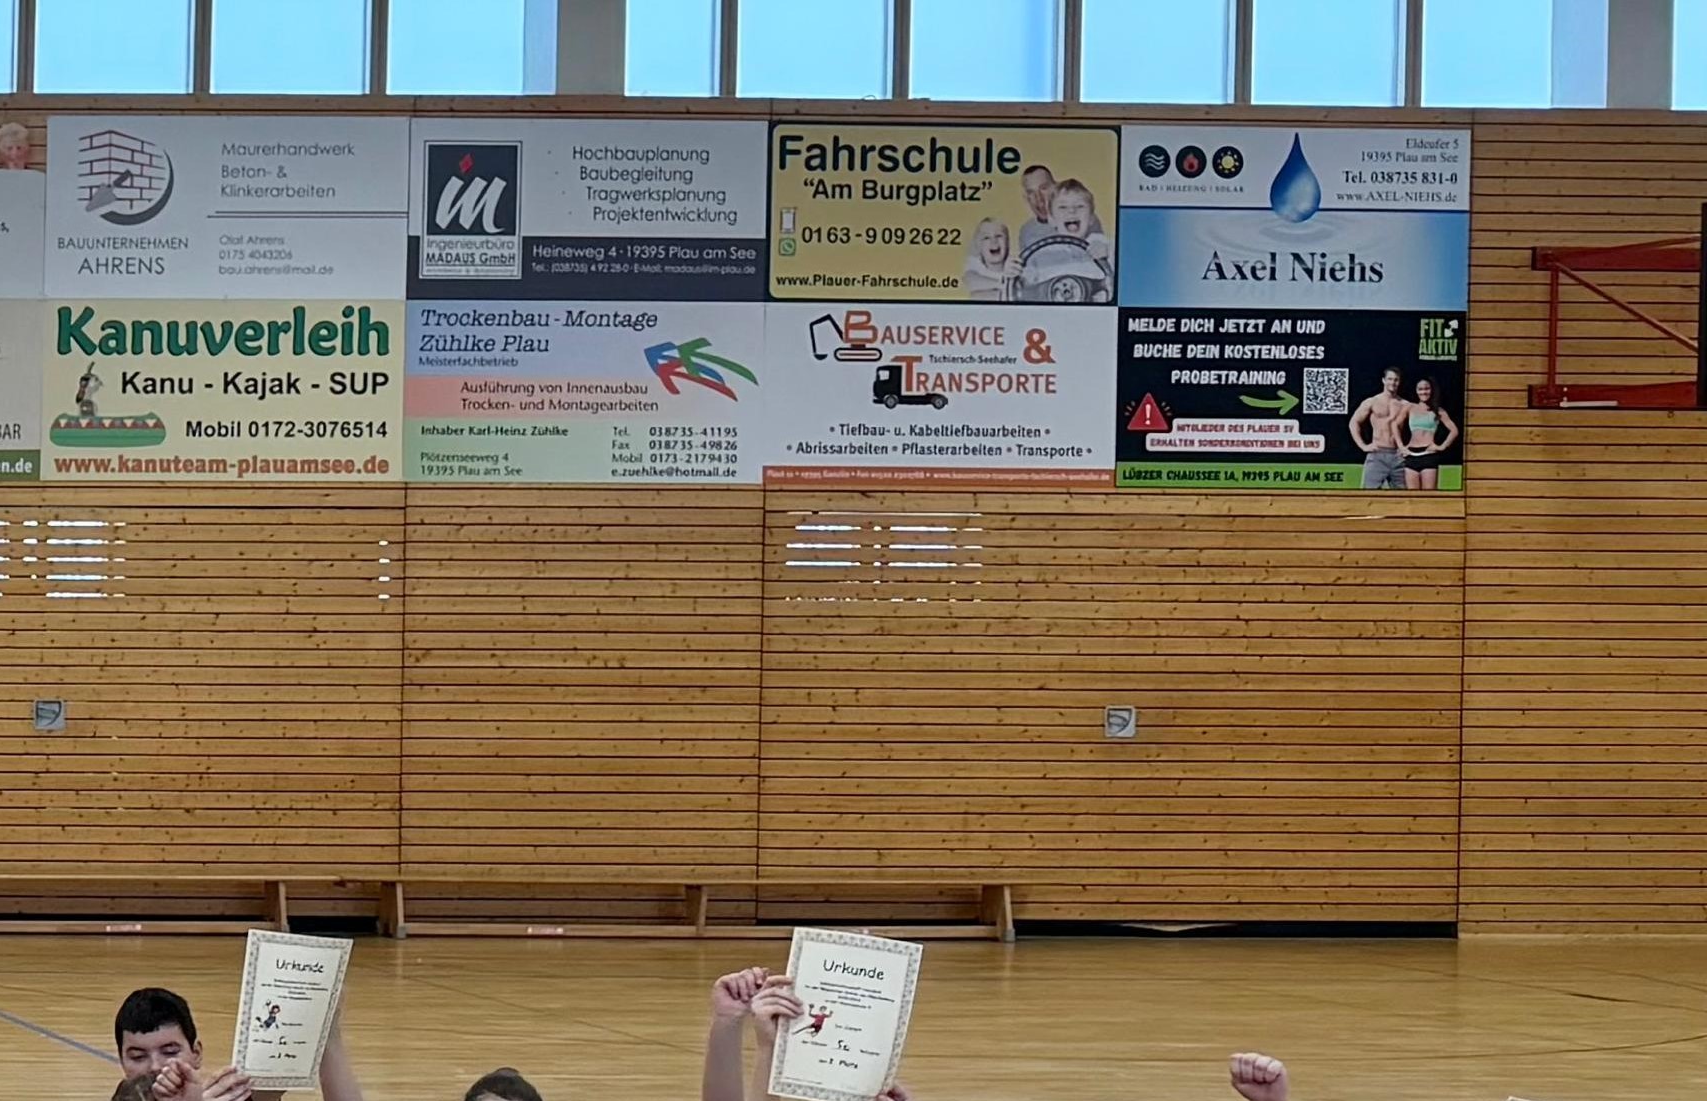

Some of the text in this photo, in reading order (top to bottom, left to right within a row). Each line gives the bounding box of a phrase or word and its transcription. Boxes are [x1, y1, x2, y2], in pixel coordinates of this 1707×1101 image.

[222, 143, 355, 157] Maurerhandwerk
[572, 146, 710, 165] Hochbauplanung
[778, 135, 1021, 175] Fahrschule
[580, 166, 693, 184] Baubegleitung
[220, 185, 336, 198] Klinkerarbeiten
[586, 187, 726, 205] Tragwerksplanung
[593, 207, 737, 225] Projektentwicklung
[57, 237, 189, 250] BAUUNTERNEHMEN
[77, 257, 165, 275] AHRENS
[1201, 251, 1384, 283] Axel Niehs
[775, 275, 959, 289] www.Plauer-Fahrschule.de
[421, 309, 550, 327] Trockenbau
[1128, 319, 1326, 334] MELDE DICH JETZT AN UND
[57, 305, 390, 357] Kanuverleih
[1420, 318, 1445, 337] FIT
[419, 335, 549, 352] Zühlke Plau
[1133, 344, 1325, 360] BUCHE DEIN KOSTENLOSES
[1419, 339, 1458, 355] AKTIV
[121, 371, 389, 400] Kanu Kajak SUP
[1170, 370, 1286, 385] PROBETRAINING
[548, 399, 659, 413] Montagearbeiten
[185, 421, 387, 438] Mobil 0172-3076514
[839, 424, 1041, 439] Tiefbau- Kabeltiefbauarbeiten
[796, 442, 1002, 457] Abrissarbeiten Pflasterarbeiten
[54, 455, 389, 477] www.kanuteam-plauamsee.de
[823, 959, 884, 980] Urkunde
